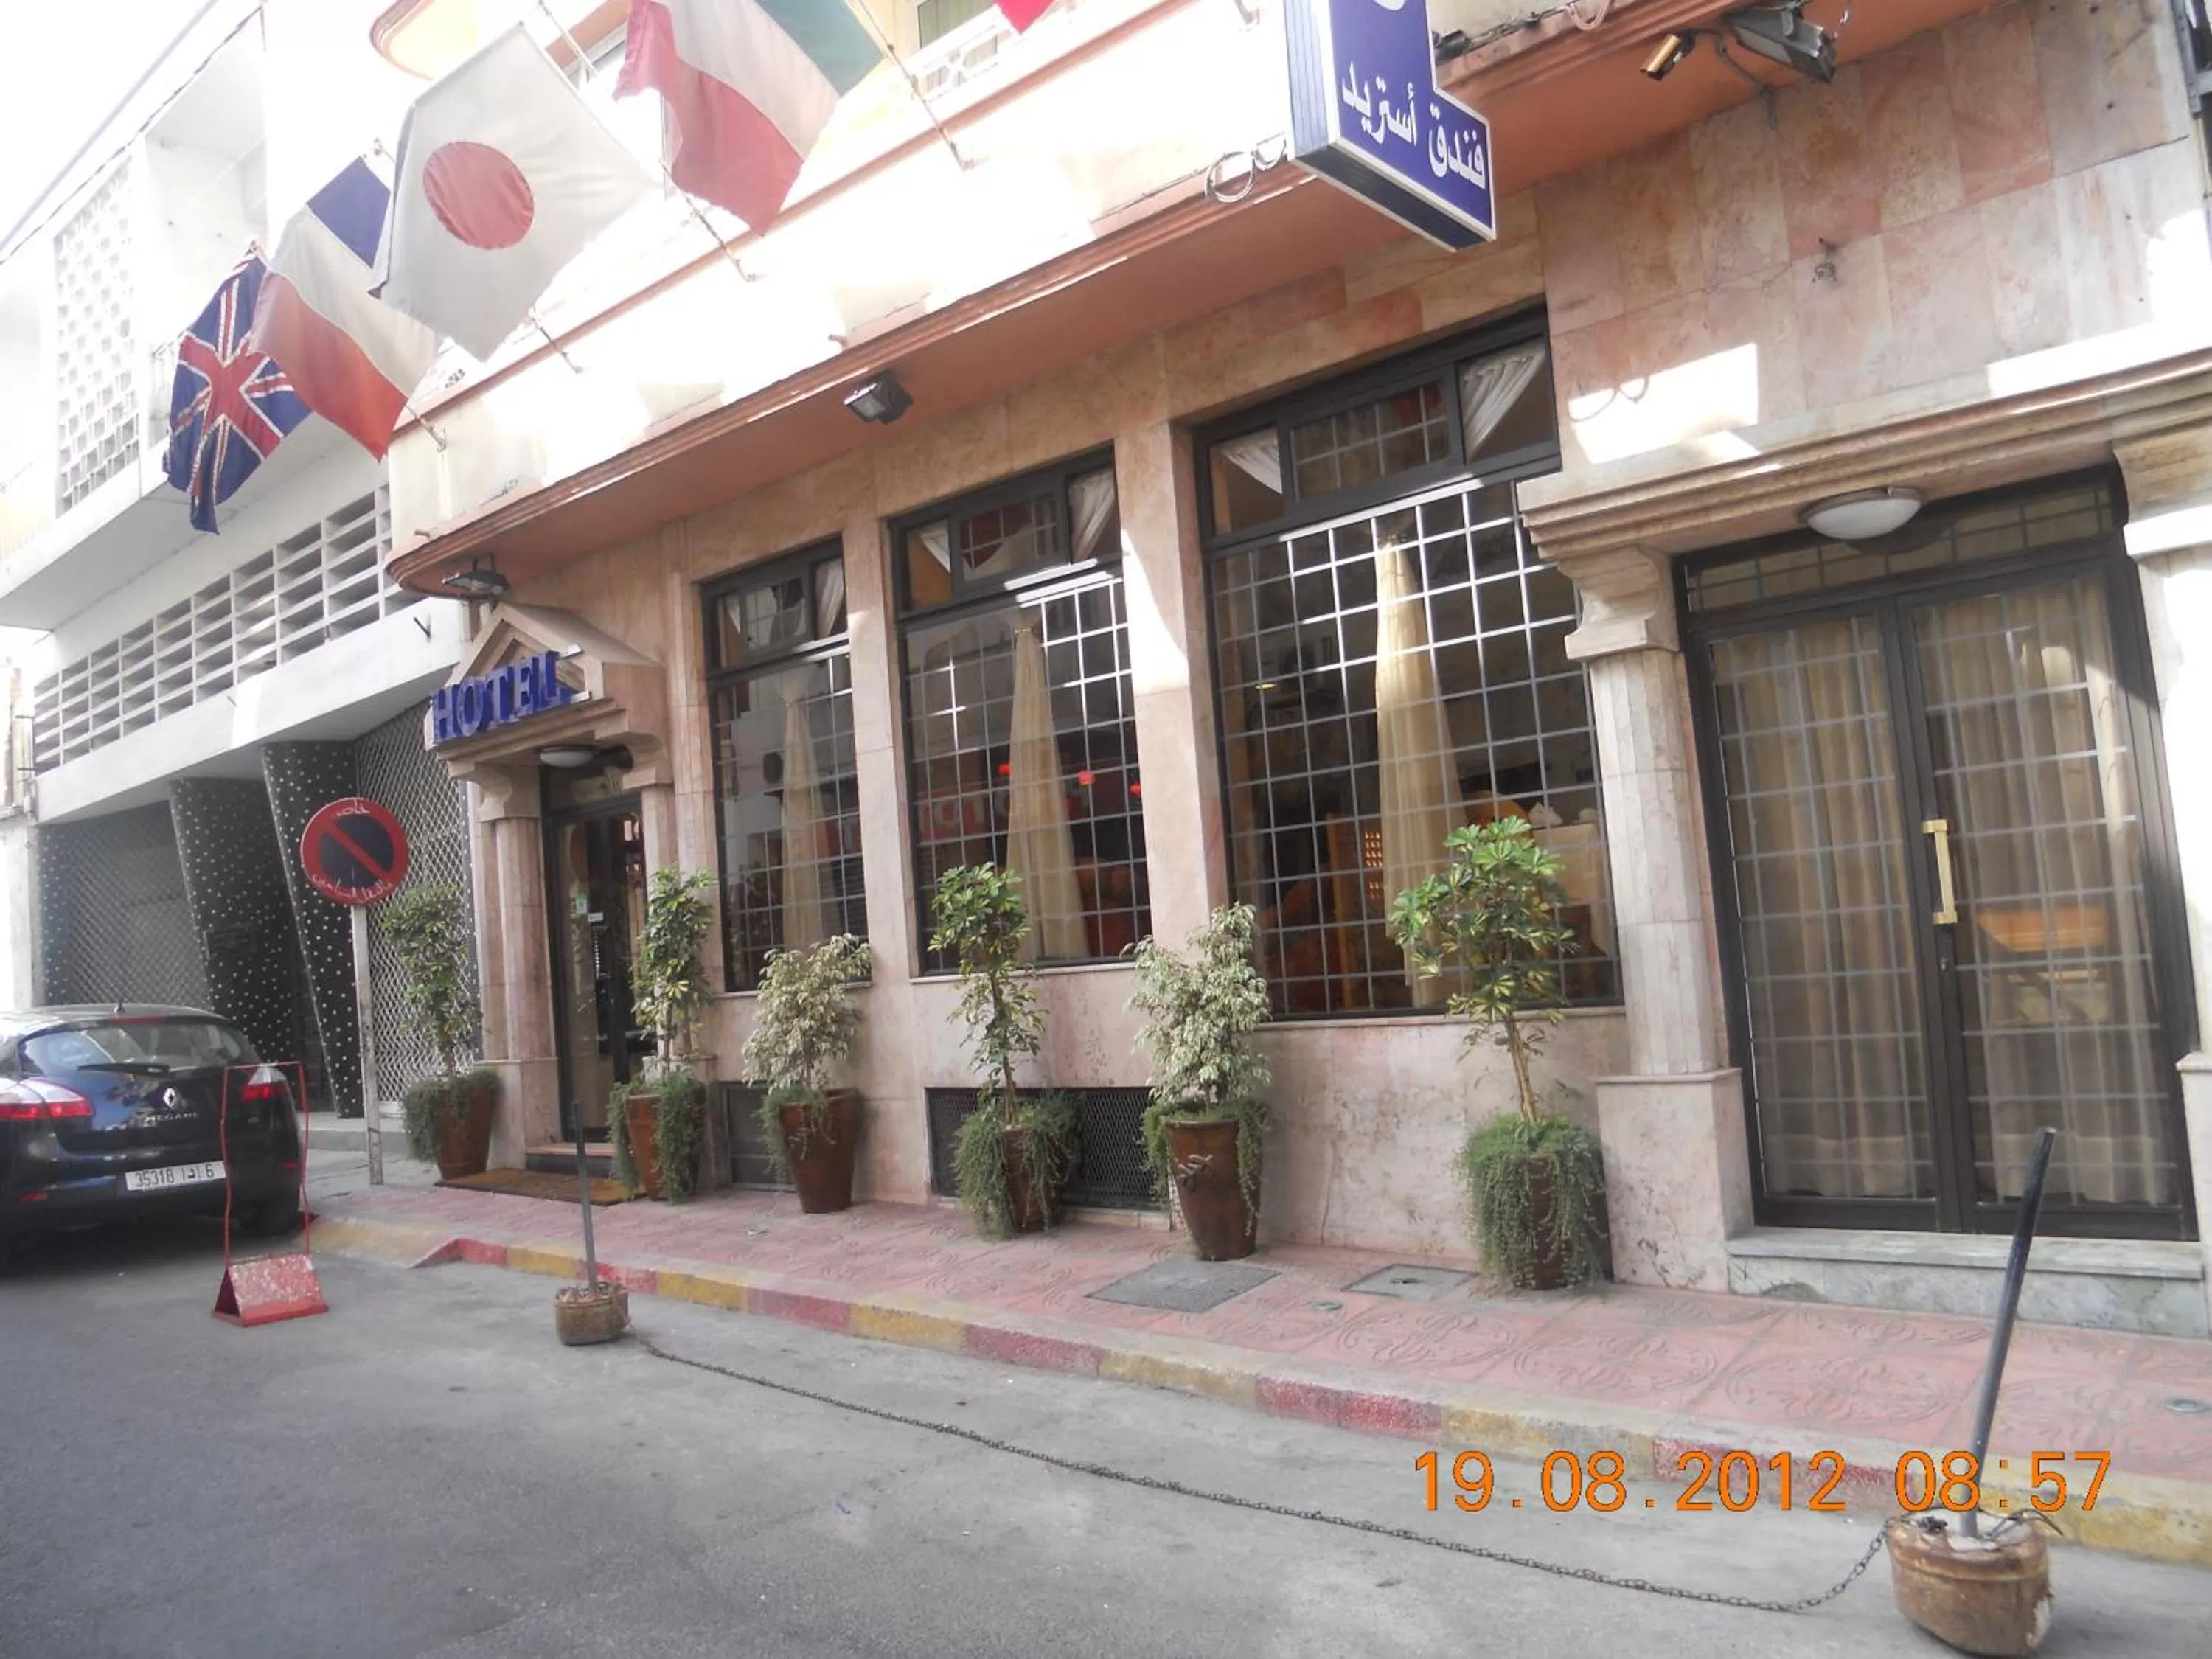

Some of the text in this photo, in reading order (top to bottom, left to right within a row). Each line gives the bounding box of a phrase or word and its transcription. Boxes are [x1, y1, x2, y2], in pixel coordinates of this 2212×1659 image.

[1341, 62, 1485, 189] فندق أستريد
[433, 651, 570, 742] HOTEL
